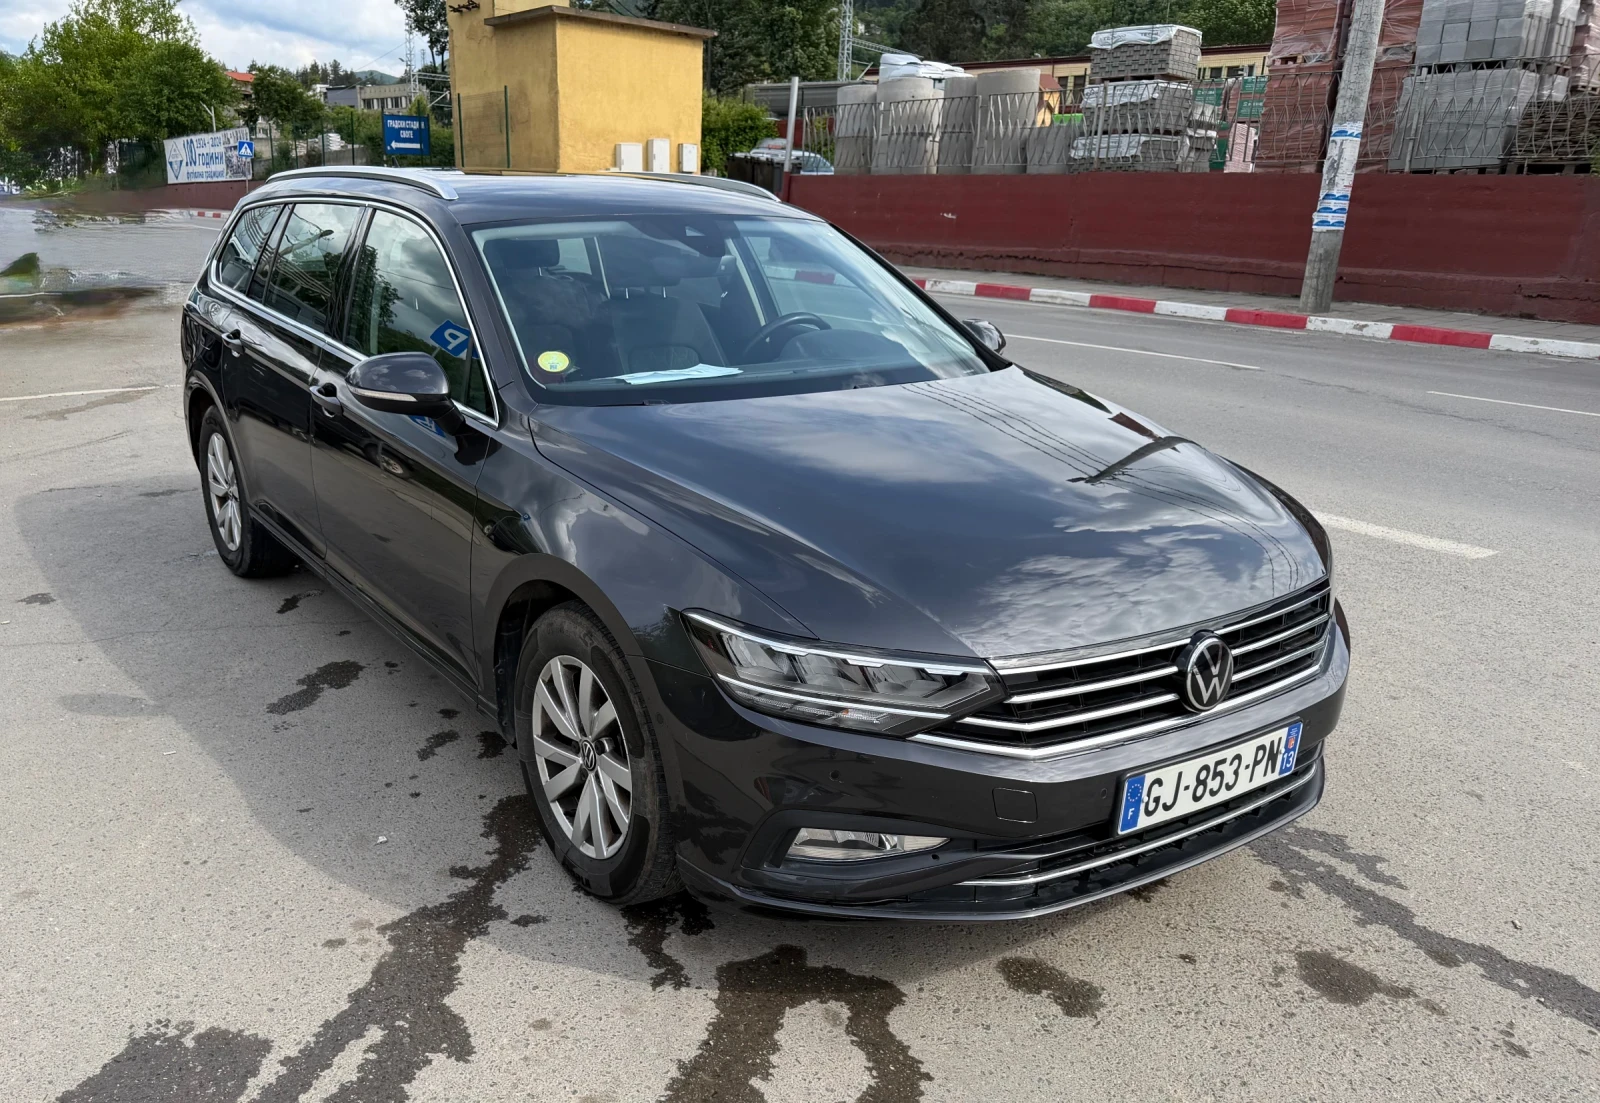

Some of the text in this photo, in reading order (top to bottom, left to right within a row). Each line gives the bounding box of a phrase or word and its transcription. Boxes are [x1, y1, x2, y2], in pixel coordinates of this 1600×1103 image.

[406, 120, 425, 129] СТАДИН
[400, 130, 413, 138] СВОГЕ
[1282, 751, 1294, 769] 13
[1127, 736, 1283, 820] F GJ-853-PN
